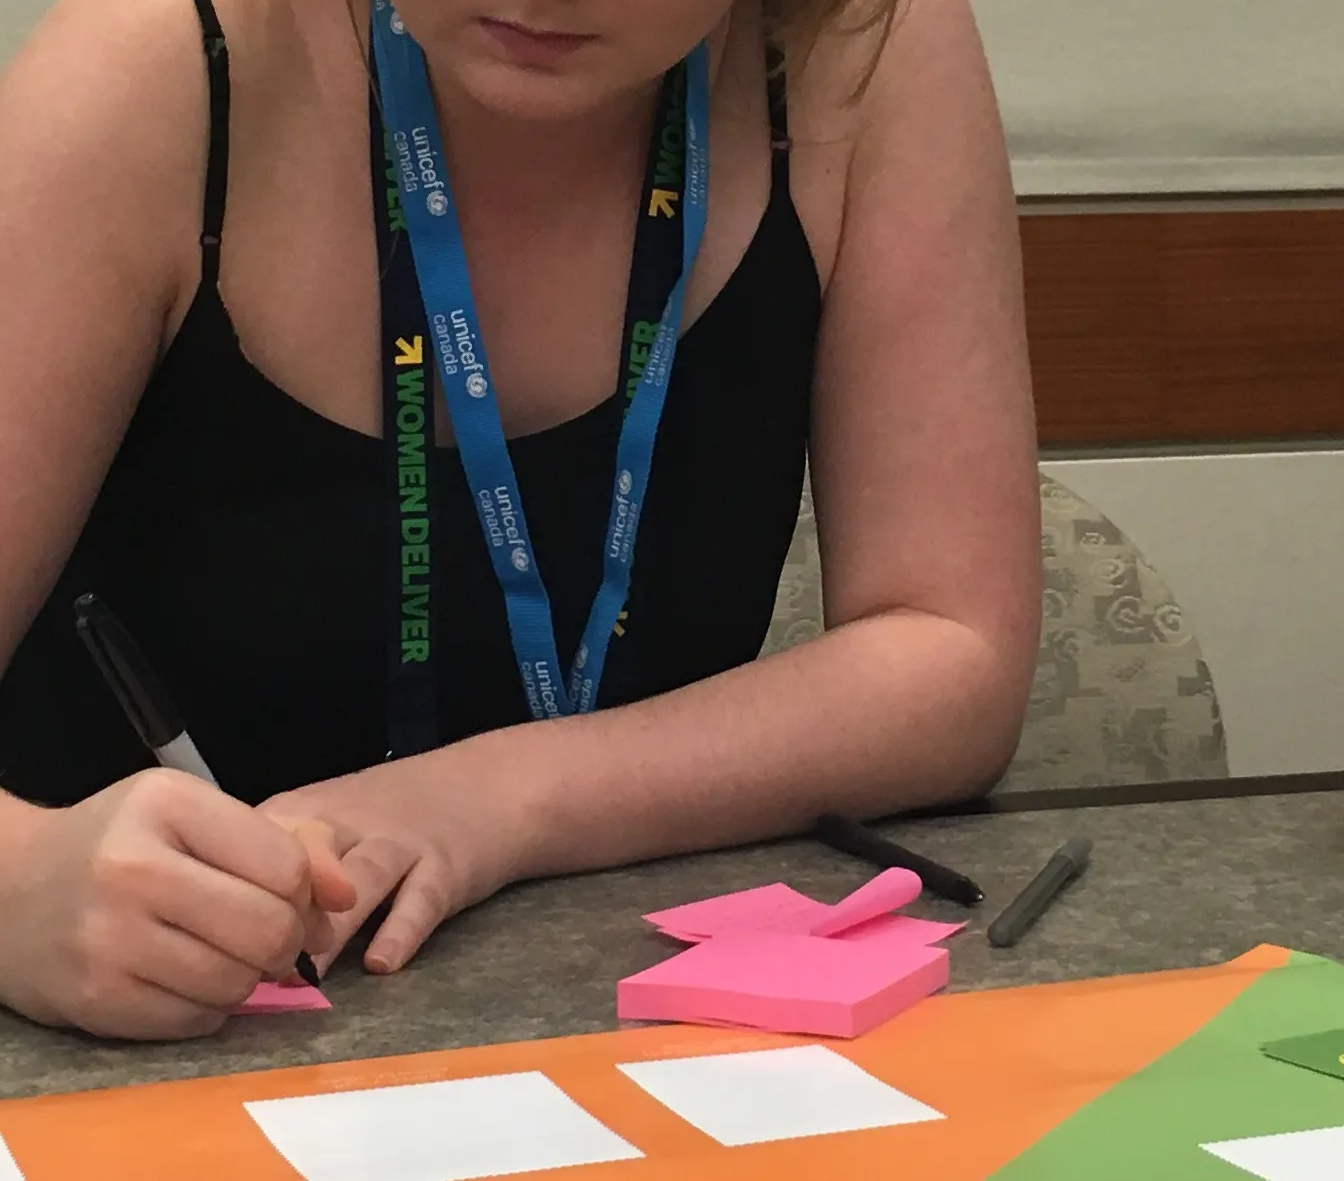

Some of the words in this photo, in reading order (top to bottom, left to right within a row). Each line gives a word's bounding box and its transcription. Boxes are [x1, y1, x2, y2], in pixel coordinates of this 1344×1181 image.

[393, 130, 418, 193] canada
[412, 125, 445, 195] unicef
[433, 314, 457, 375] canada
[451, 309, 483, 376] unicef
[396, 368, 426, 512] WOMEN
[478, 490, 500, 547] canada
[494, 485, 524, 551] unicef
[609, 492, 632, 558] unicef
[619, 502, 638, 563] canada
[401, 518, 430, 665] DELIVER
